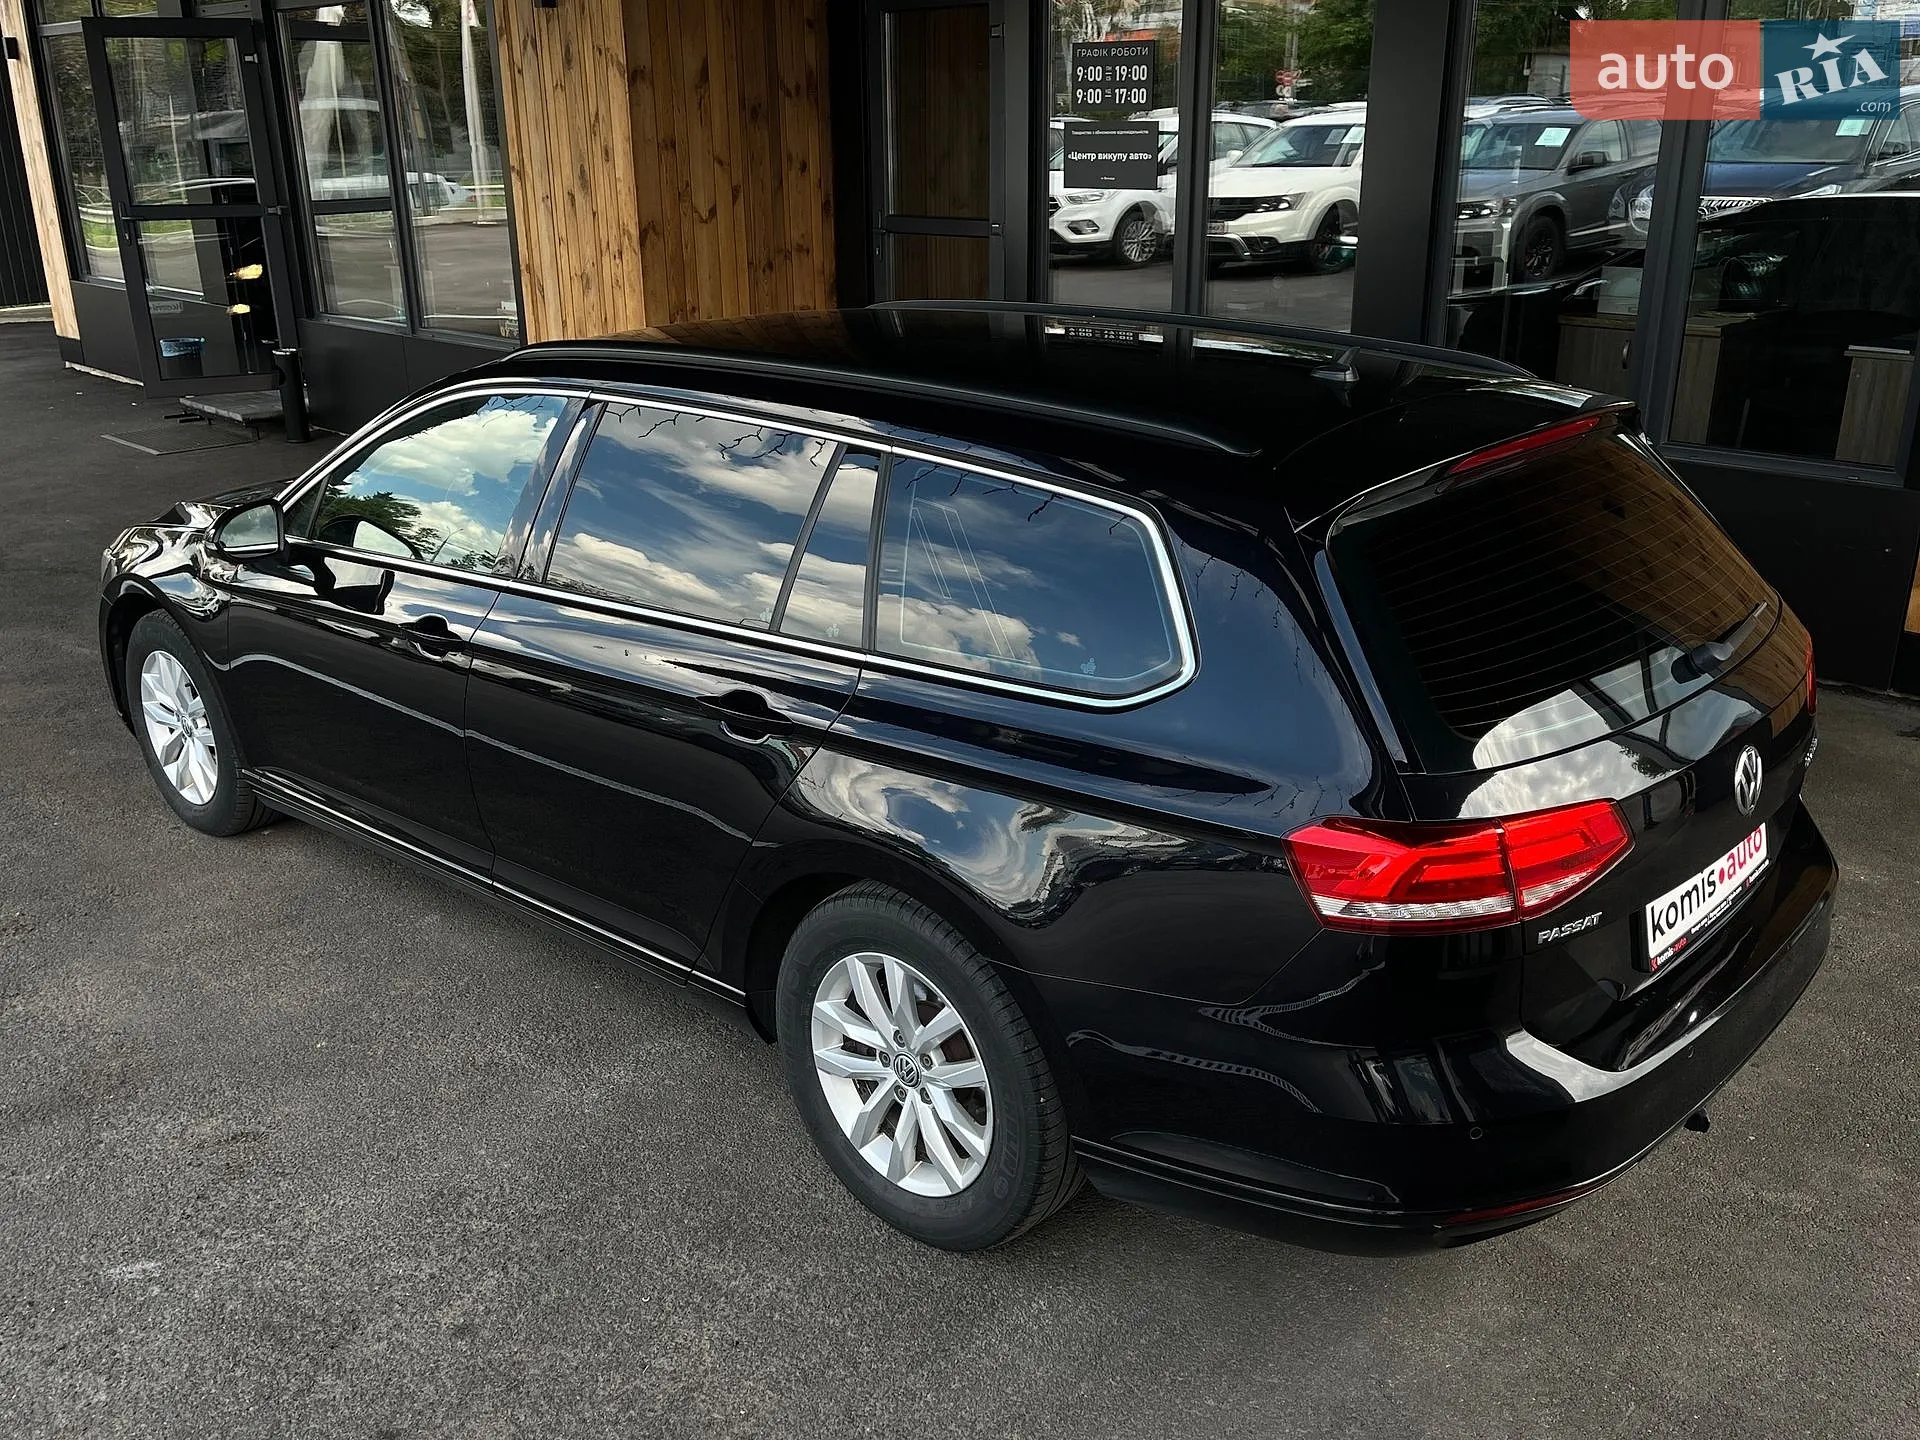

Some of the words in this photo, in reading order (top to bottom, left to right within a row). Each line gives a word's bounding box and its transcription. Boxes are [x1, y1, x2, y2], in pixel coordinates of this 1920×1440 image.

[1076, 48, 1109, 57] ГРАФІК
[1111, 46, 1149, 56] РОБОТИ
[1076, 66, 1103, 82] 9:00
[1115, 65, 1148, 81] 19:00
[1076, 88, 1102, 104] 9:00
[1114, 88, 1147, 104] 17:00
[1097, 152, 1128, 162] викупу
[1537, 911, 1603, 945] PASSAT
